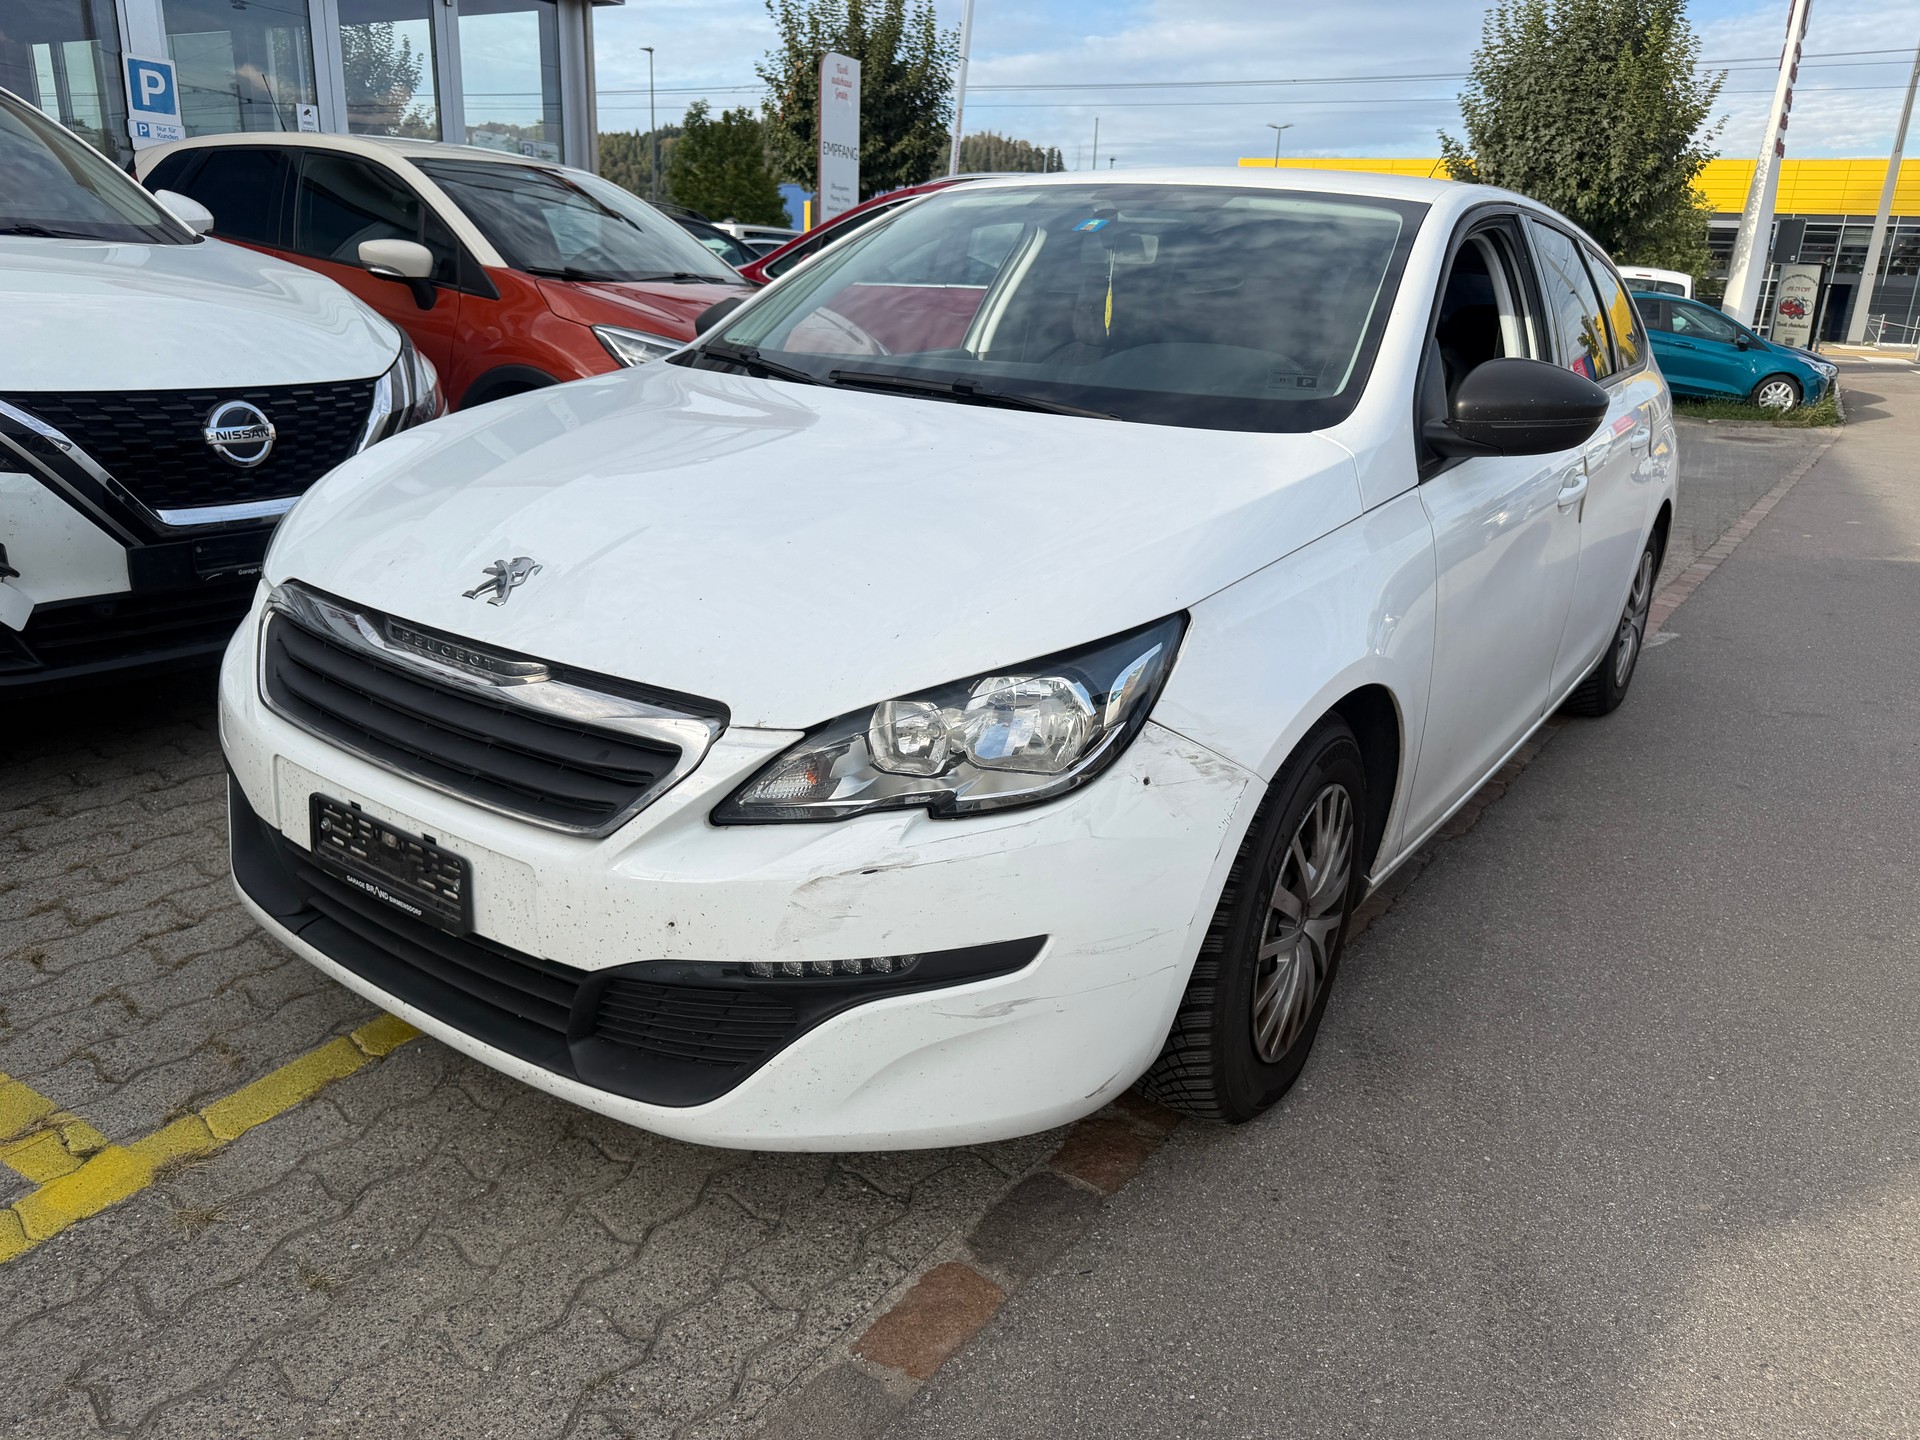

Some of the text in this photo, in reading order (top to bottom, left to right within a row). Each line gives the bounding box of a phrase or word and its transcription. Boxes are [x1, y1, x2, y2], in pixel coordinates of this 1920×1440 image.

[139, 68, 166, 106] P
[139, 124, 148, 136] P
[168, 126, 177, 134] für
[157, 132, 179, 141] Kunden
[823, 141, 859, 161] EMPFANG
[1302, 378, 1313, 386] P
[215, 428, 270, 441] NISSAN
[238, 568, 258, 576] Garage
[402, 630, 495, 670] PEUGEOT
[346, 874, 422, 916] GARAGE BRAND BIRMENSDORF
